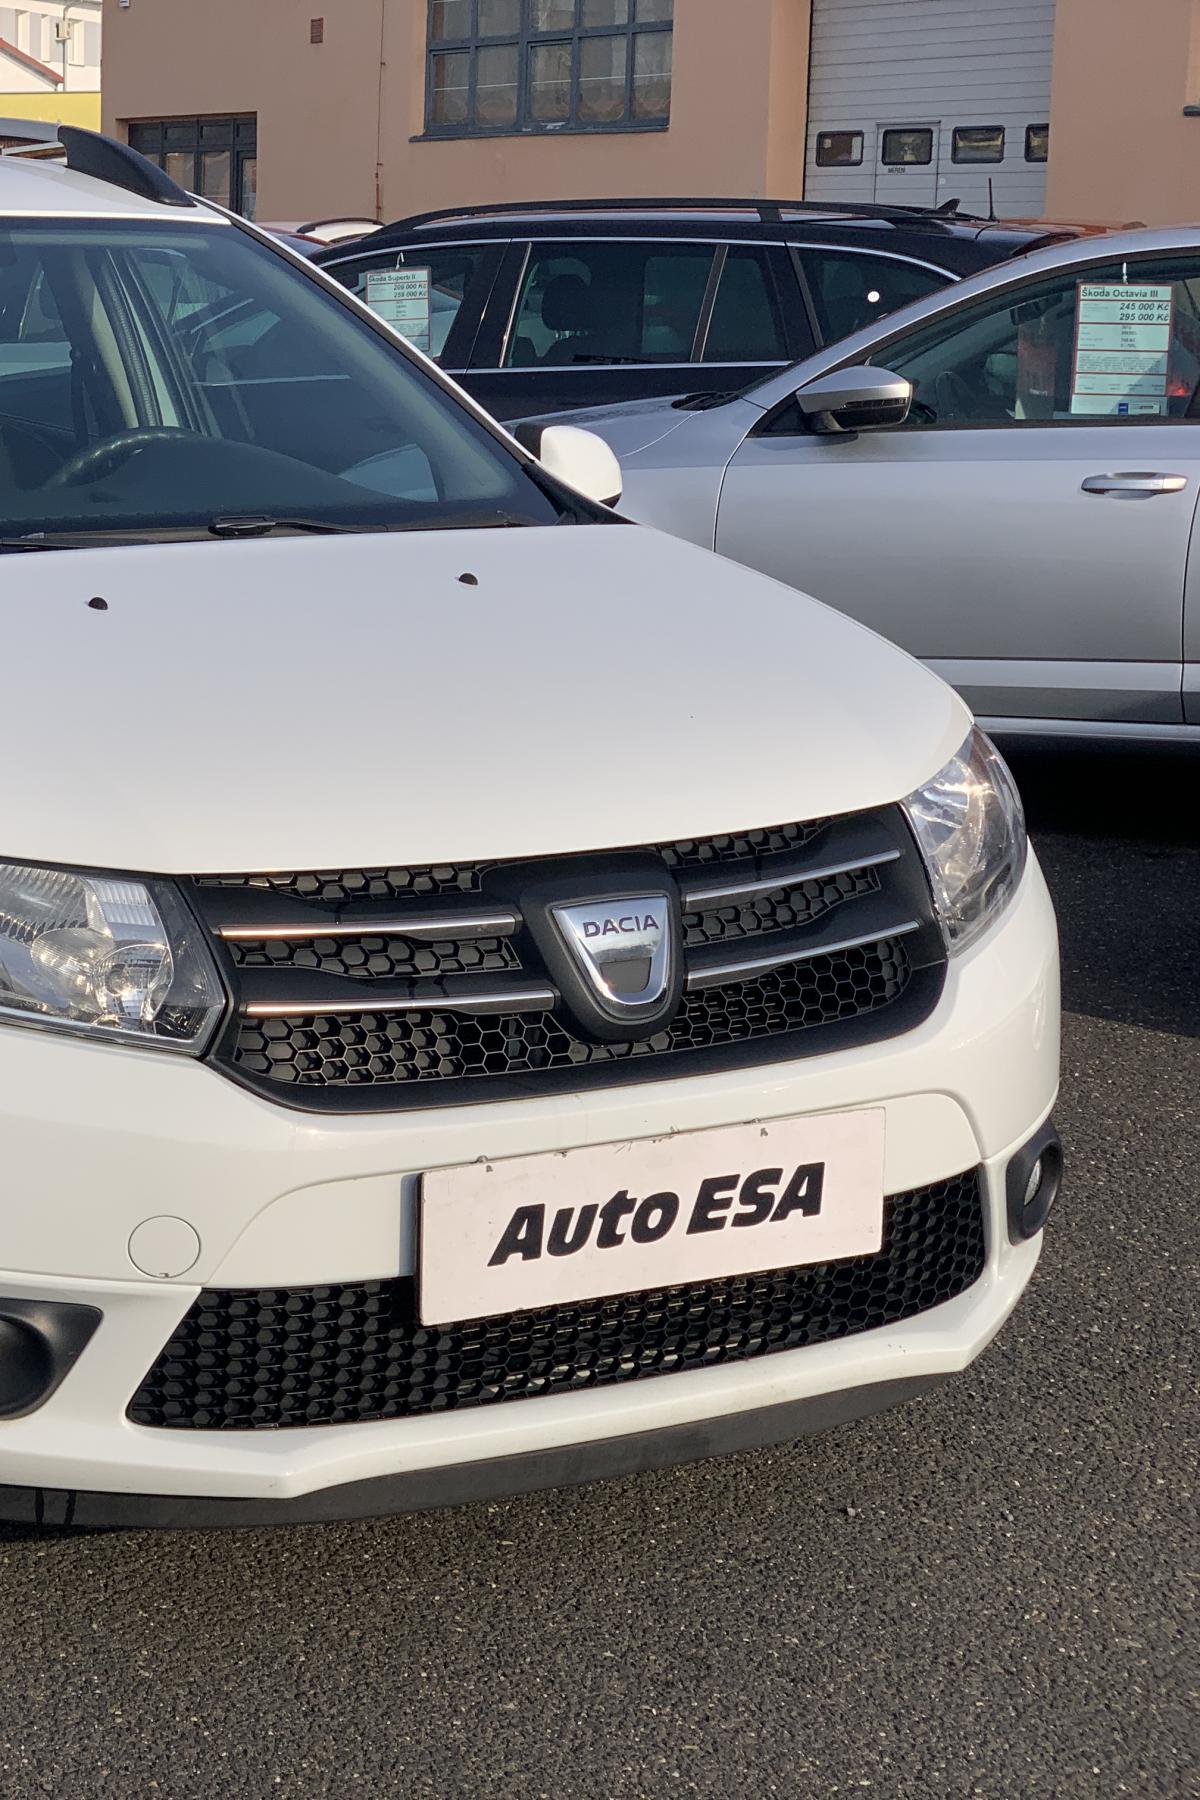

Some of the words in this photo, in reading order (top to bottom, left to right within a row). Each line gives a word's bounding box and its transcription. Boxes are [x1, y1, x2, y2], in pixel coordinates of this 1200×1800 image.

[1081, 287, 1110, 297] Škoda
[1112, 289, 1147, 298] Octavia
[1150, 289, 1158, 298] III
[1120, 302, 1136, 311] 245
[1139, 302, 1155, 311] 000
[1157, 302, 1169, 311] Kč
[1119, 312, 1136, 321] 295
[1138, 312, 1154, 321] 000
[1156, 312, 1169, 321] Kč
[583, 914, 659, 937] DACIA
[487, 1189, 679, 1267] Auto
[686, 1161, 826, 1236] ESA
